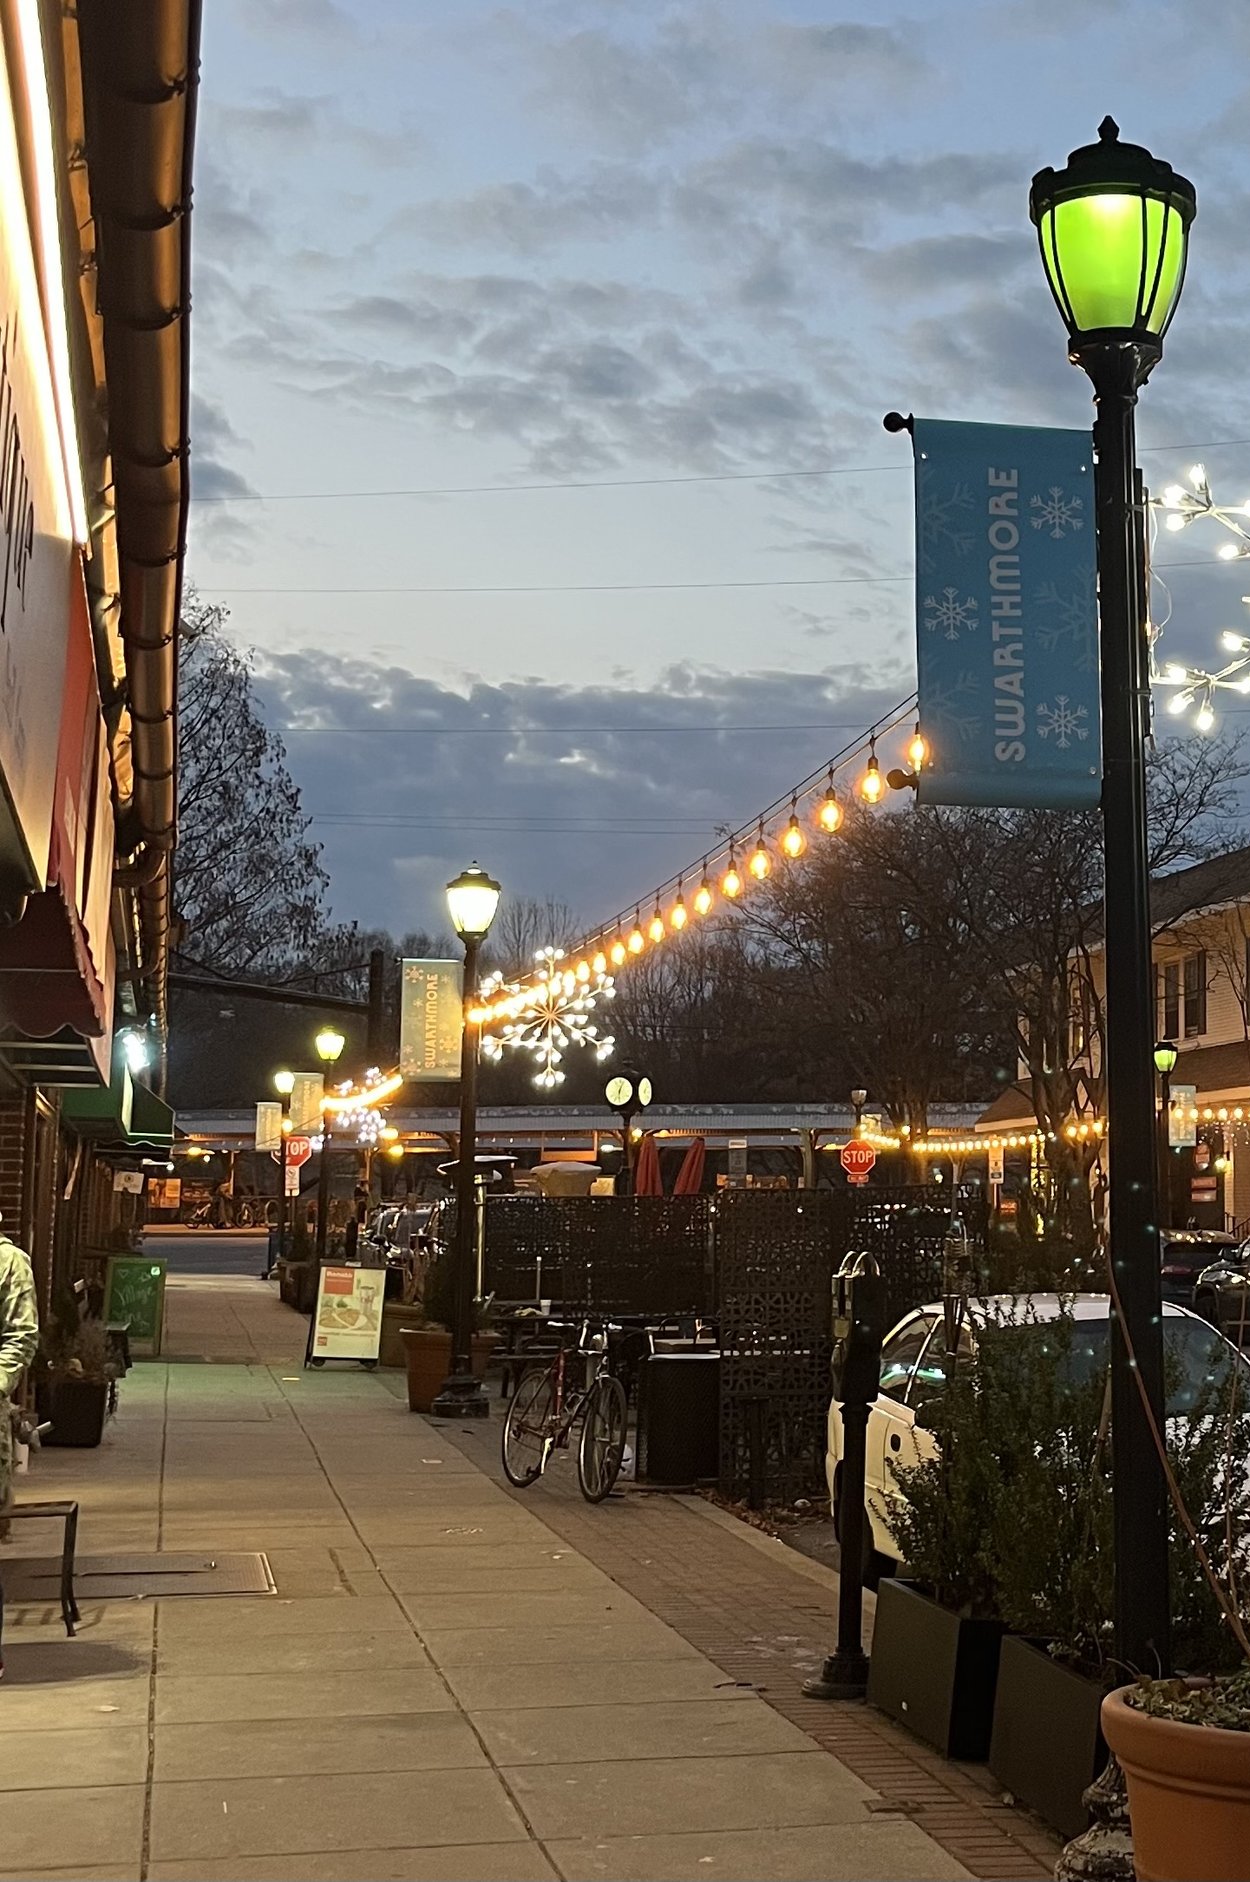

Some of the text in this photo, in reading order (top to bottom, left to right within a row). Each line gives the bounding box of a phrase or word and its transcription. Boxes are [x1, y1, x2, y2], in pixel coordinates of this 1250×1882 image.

[987, 466, 1027, 763] SWARTHMORE
[424, 973, 439, 1069] SWARTHMORE
[843, 1150, 873, 1164] STOP
